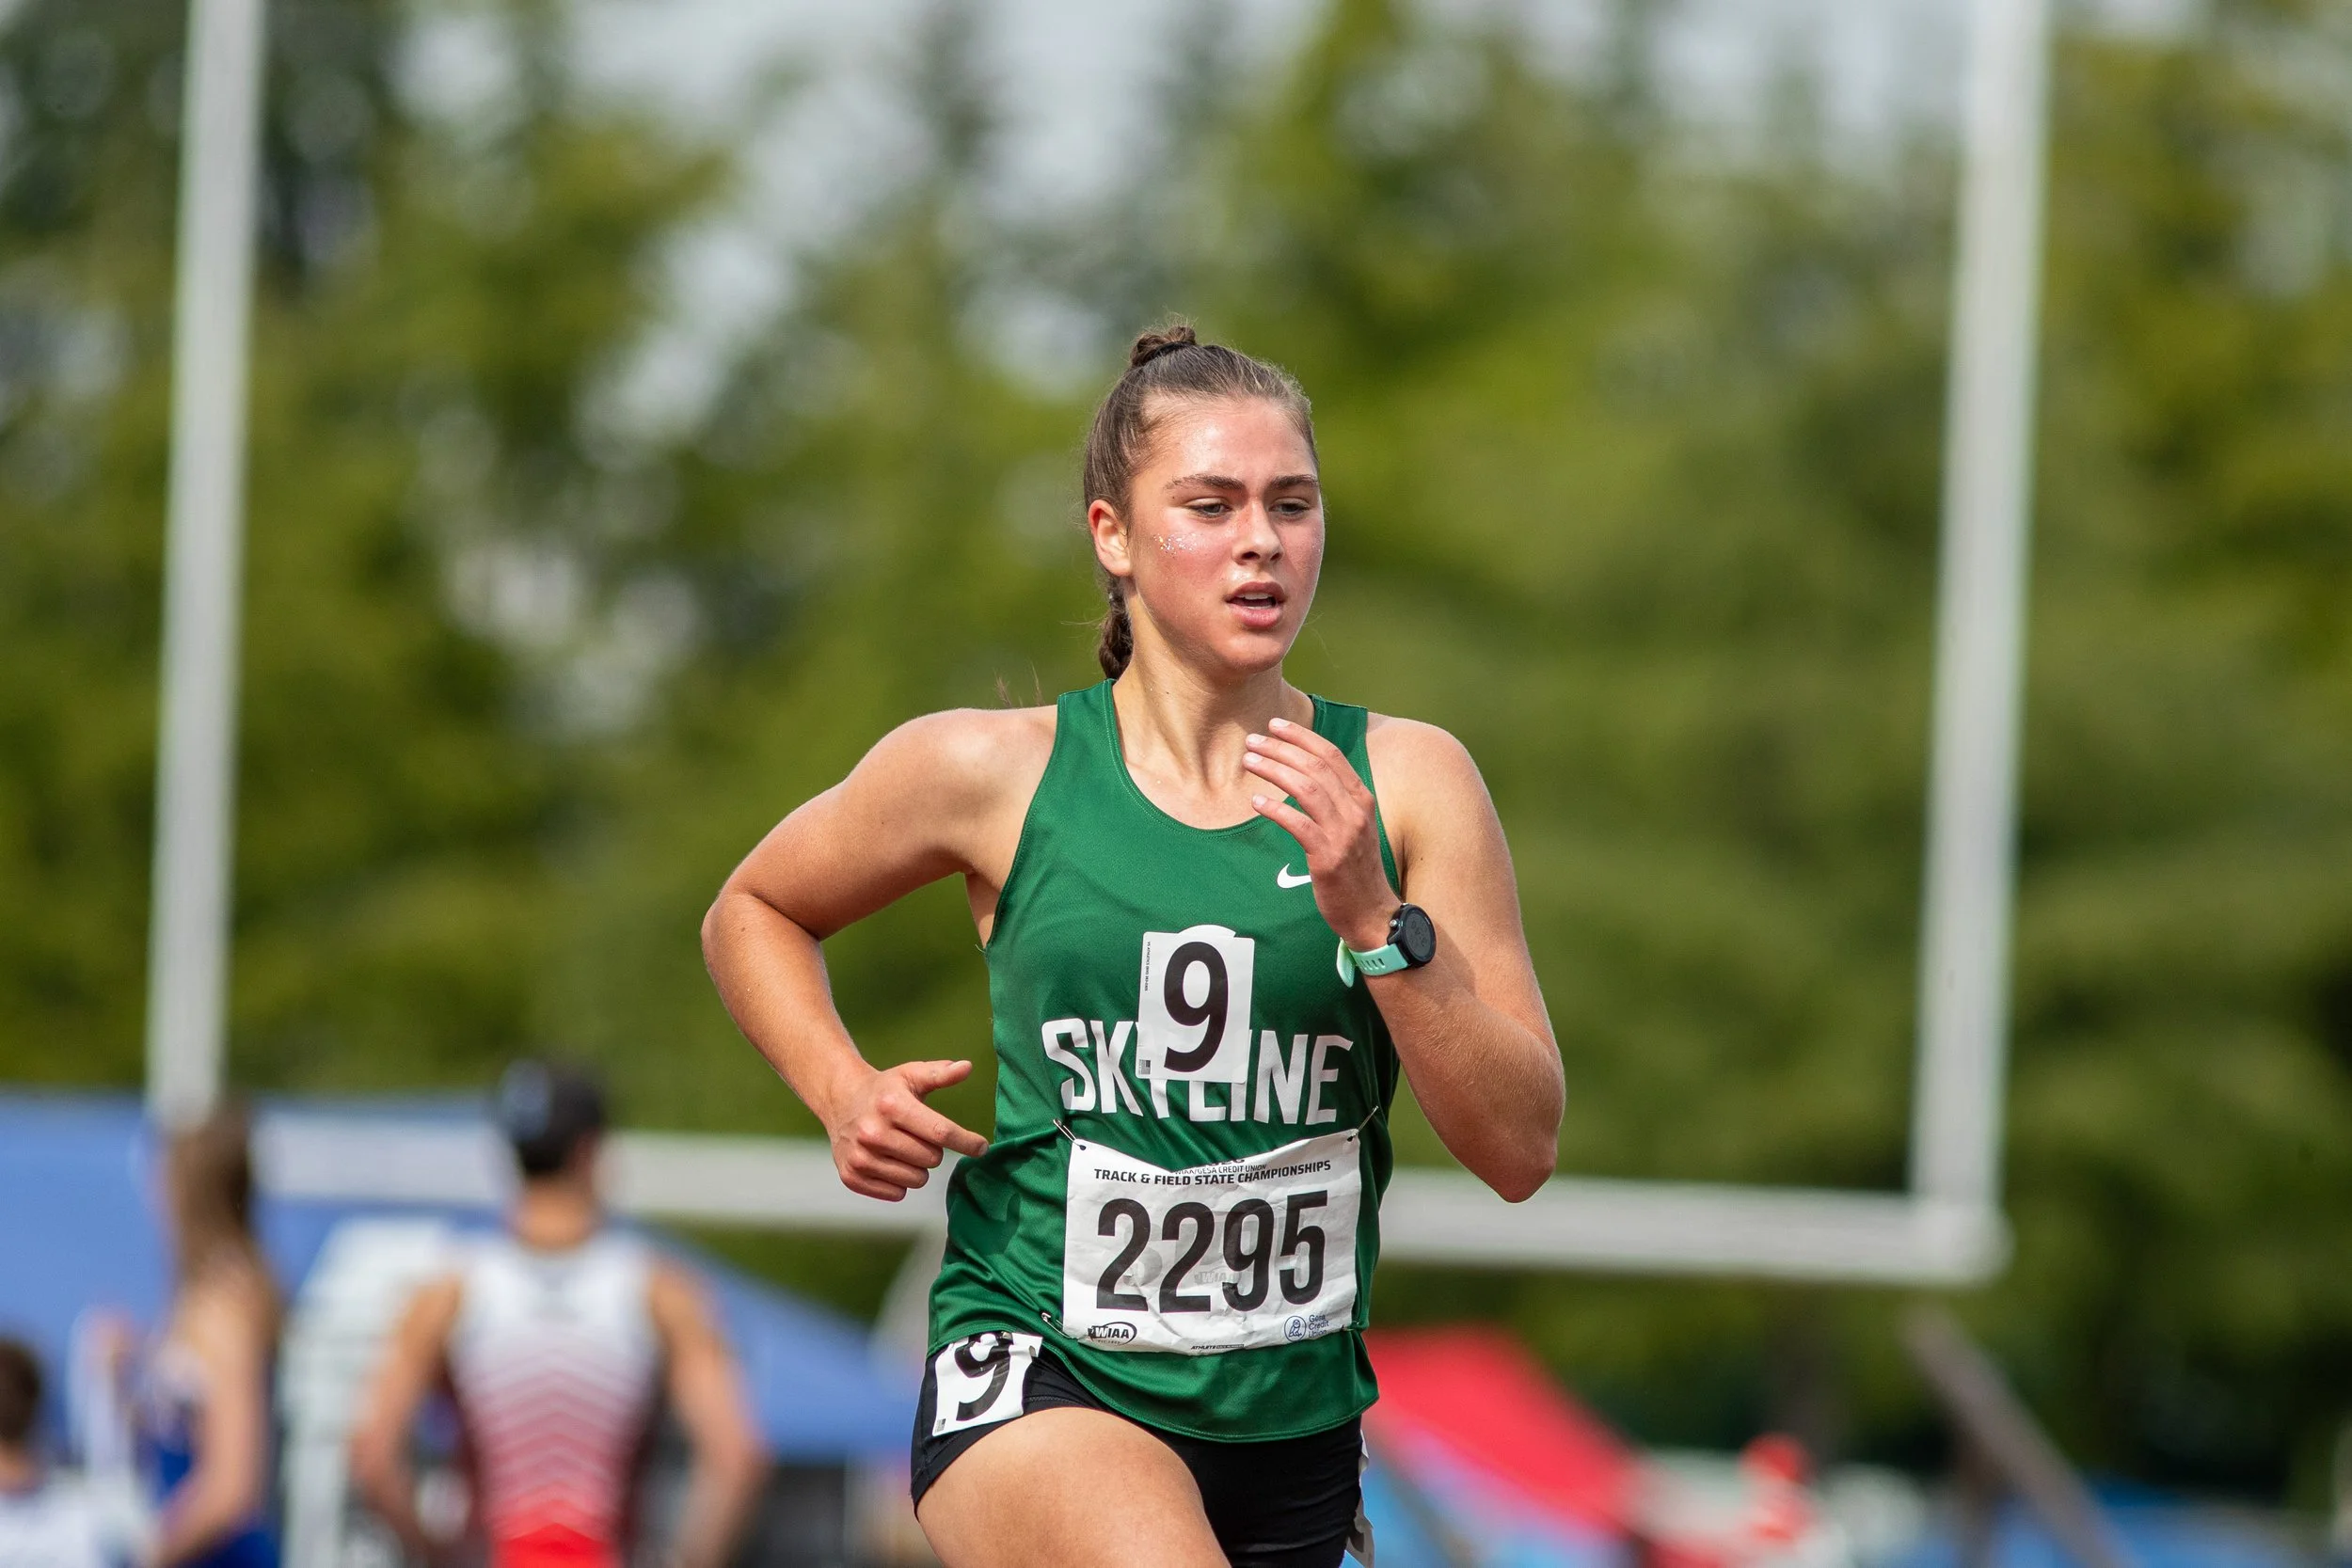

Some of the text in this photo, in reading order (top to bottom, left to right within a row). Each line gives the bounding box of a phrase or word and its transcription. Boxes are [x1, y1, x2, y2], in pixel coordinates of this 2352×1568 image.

[1164, 941, 1229, 1073] 9
[1094, 1168, 1136, 1183] TRACK
[1140, 1173, 1151, 1184] &
[1154, 1175, 1190, 1186] FIELD
[1195, 1174, 1234, 1185] STATE
[1237, 1160, 1331, 1183] CHAMPIONSHIPS
[1218, 1165, 1243, 1174] CREDIT
[1245, 1164, 1266, 1173] UNION
[1096, 1190, 1327, 1313] 2295
[1309, 1314, 1326, 1323] Gesa
[1309, 1320, 1329, 1330] Credit
[1094, 1326, 1130, 1338] WIAA
[955, 1332, 1013, 1421] 9
